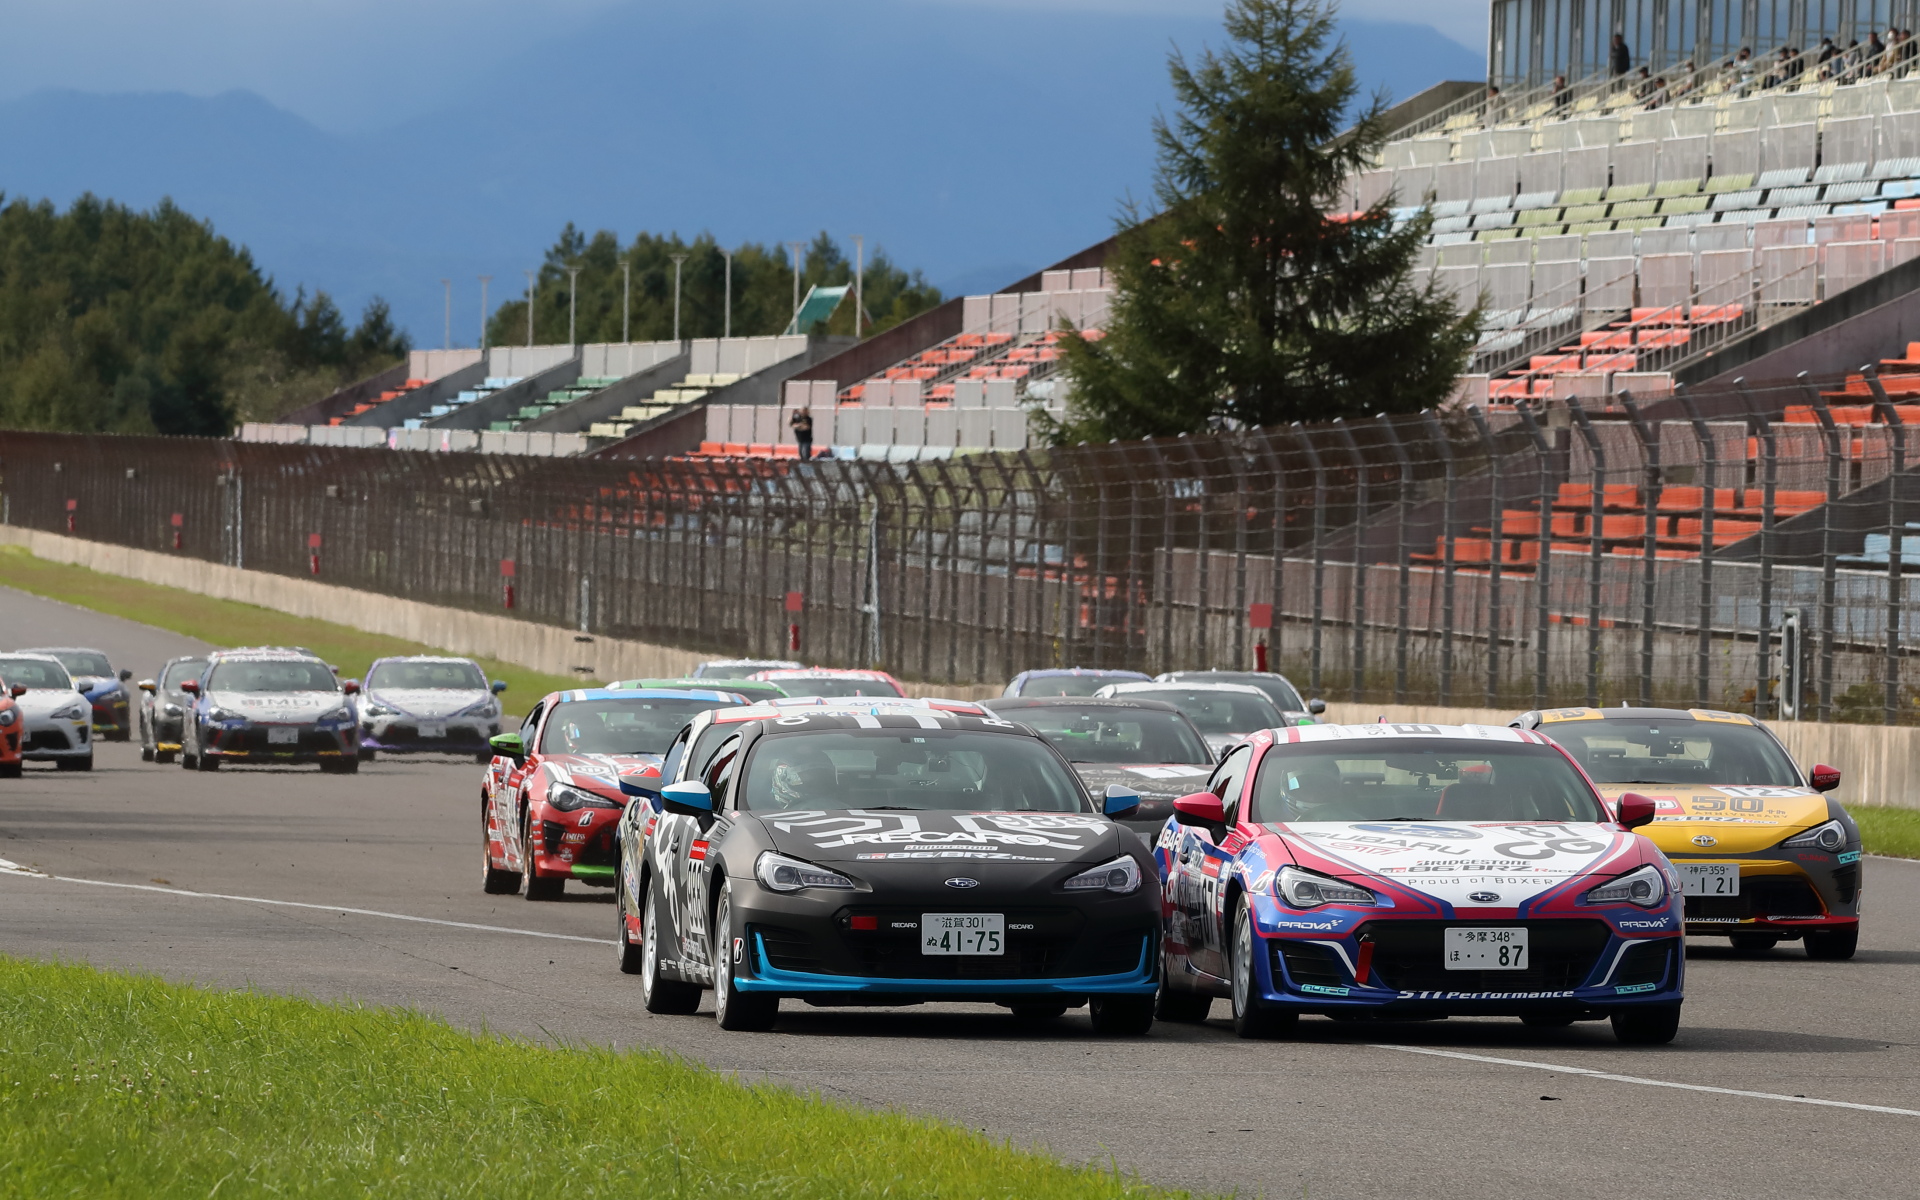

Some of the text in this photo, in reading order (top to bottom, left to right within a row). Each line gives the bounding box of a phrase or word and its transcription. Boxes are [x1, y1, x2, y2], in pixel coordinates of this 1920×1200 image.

[1691, 795, 1764, 814] 50
[1504, 824, 1582, 838] 87
[841, 831, 1050, 846] RECARO
[1300, 831, 1471, 855] SUBARU
[1493, 838, 1607, 860] CG
[1689, 865, 1726, 875] 神戸359
[1408, 877, 1460, 886] Proud
[1495, 877, 1554, 885] BOXER
[941, 916, 985, 928] 滋賀301
[1278, 921, 1333, 930] PROVA
[926, 930, 1000, 952] ぬ 41-75
[1464, 931, 1511, 943] 多摩348
[1450, 945, 1524, 967] ほ 87
[1396, 990, 1575, 1000] STI Performance
